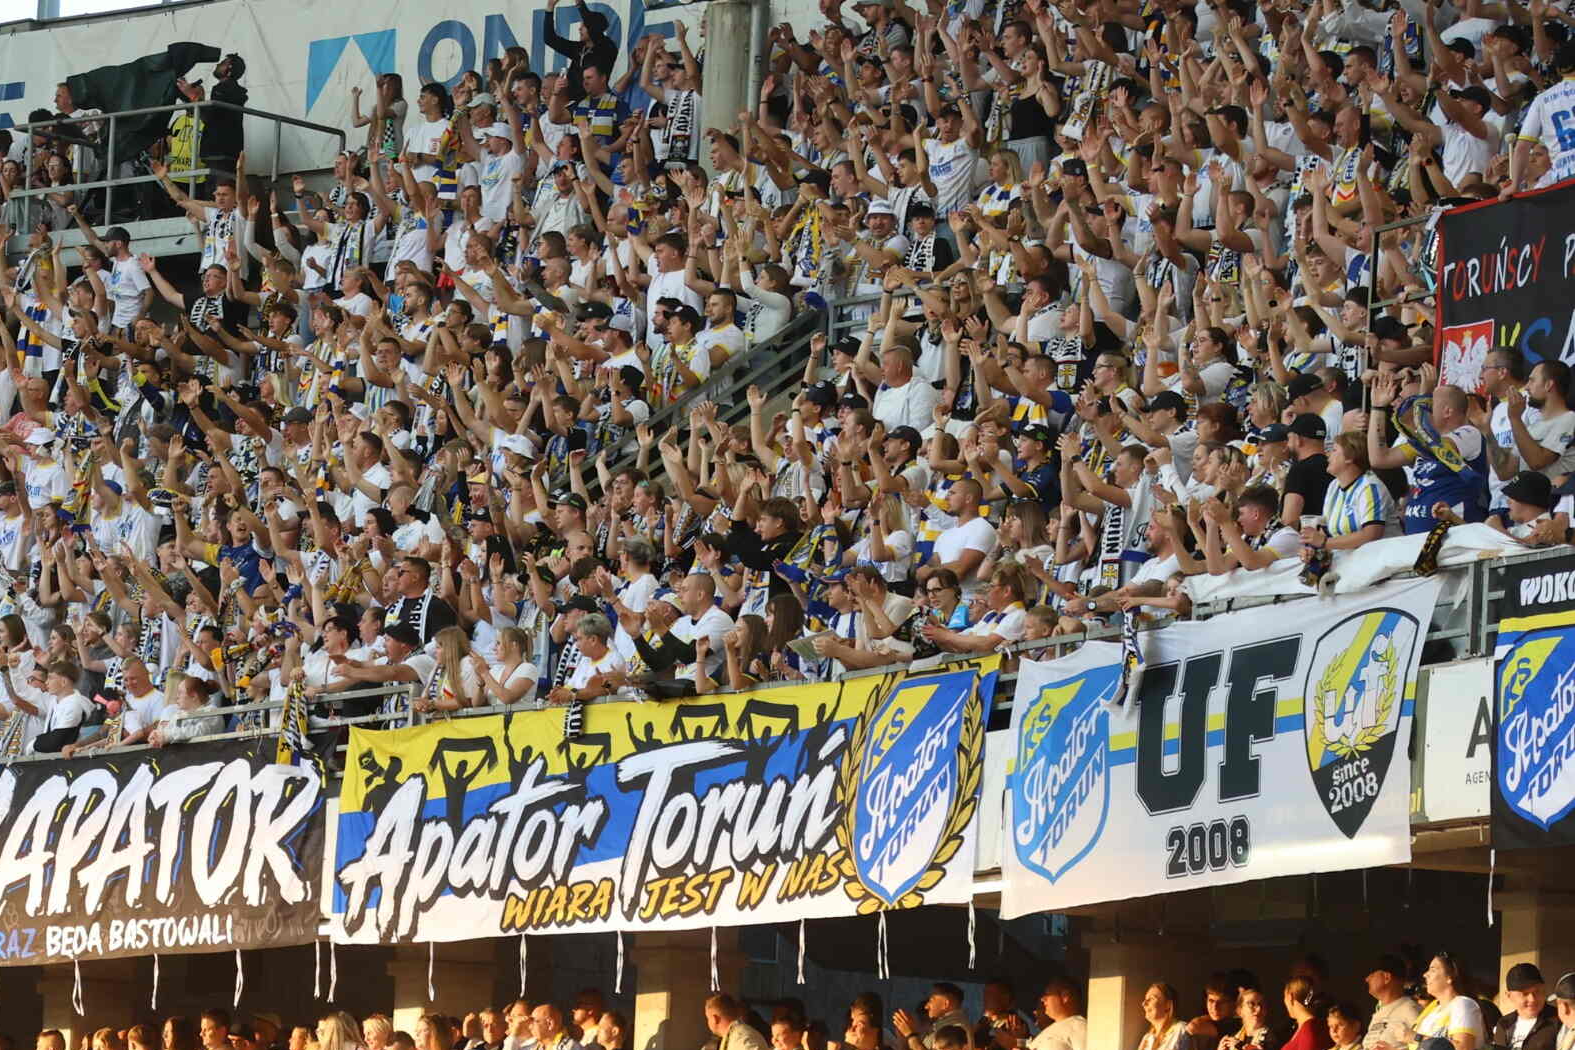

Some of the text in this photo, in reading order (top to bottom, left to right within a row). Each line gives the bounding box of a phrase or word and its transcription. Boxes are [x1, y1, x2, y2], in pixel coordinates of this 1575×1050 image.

[1443, 235, 1546, 301] TORUŃSCY
[1015, 680, 1116, 847] Apator
[1135, 632, 1304, 817] UF
[1504, 667, 1575, 792] Apato
[859, 688, 968, 862] Apator
[1329, 771, 1379, 814] 2008
[1332, 756, 1370, 785] since
[338, 726, 847, 944] Apator Toruń
[1165, 814, 1252, 880] 2008
[502, 851, 846, 932] WIARA JEST W NAS
[108, 914, 234, 952] BASTOWALI
